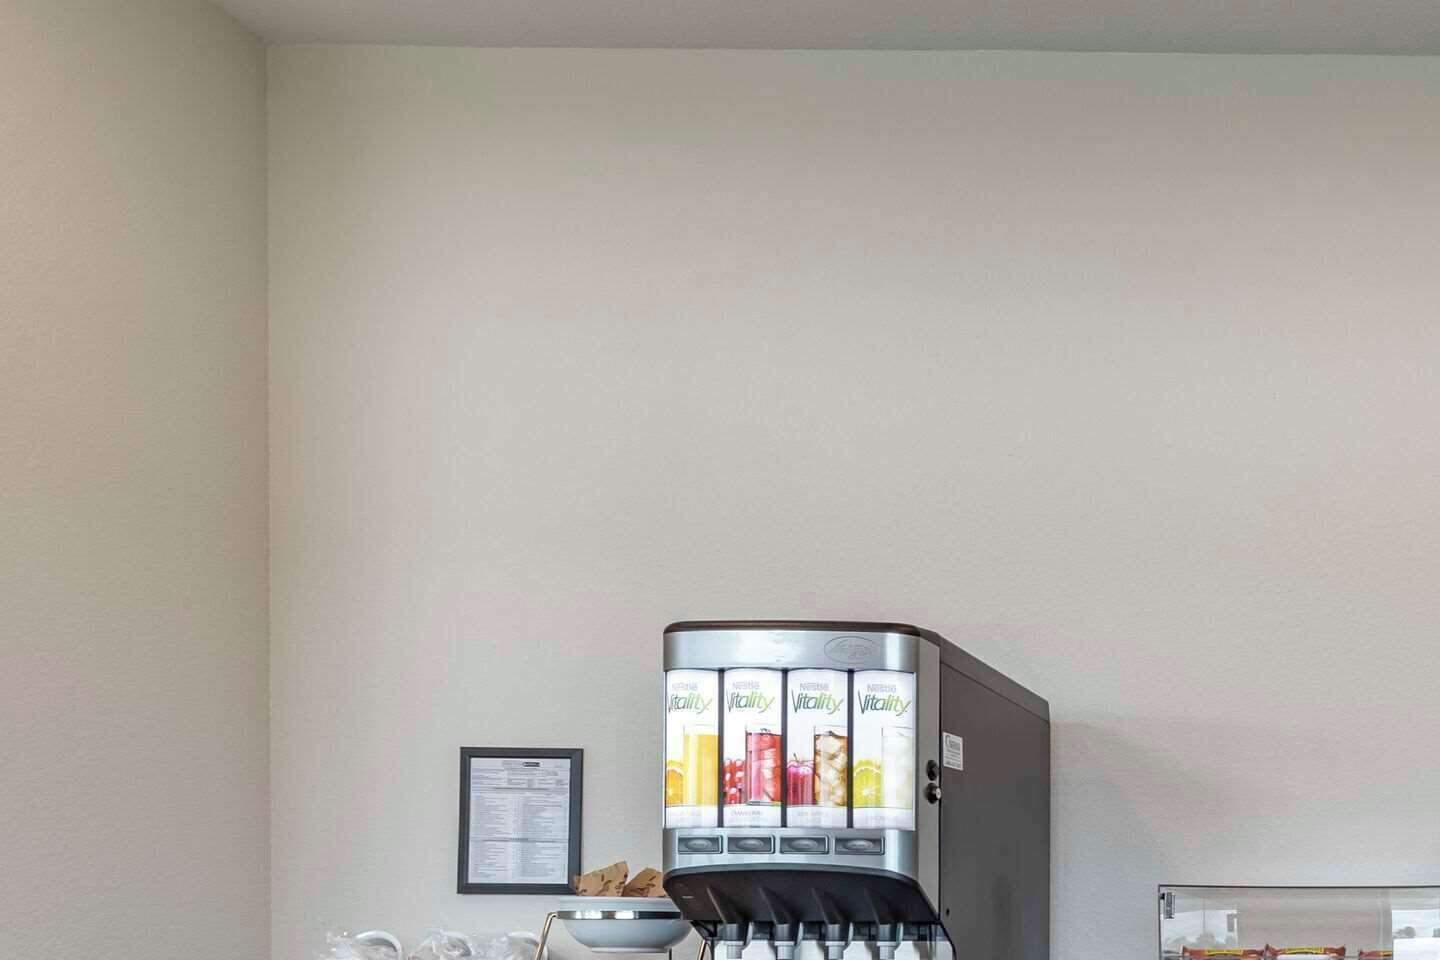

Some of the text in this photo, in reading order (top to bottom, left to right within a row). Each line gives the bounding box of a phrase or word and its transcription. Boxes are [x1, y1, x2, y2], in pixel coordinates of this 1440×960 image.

[667, 691, 713, 715] Vitality
[726, 689, 775, 714] Vitality
[791, 689, 844, 715] Vitality
[857, 690, 912, 717] Vitality
